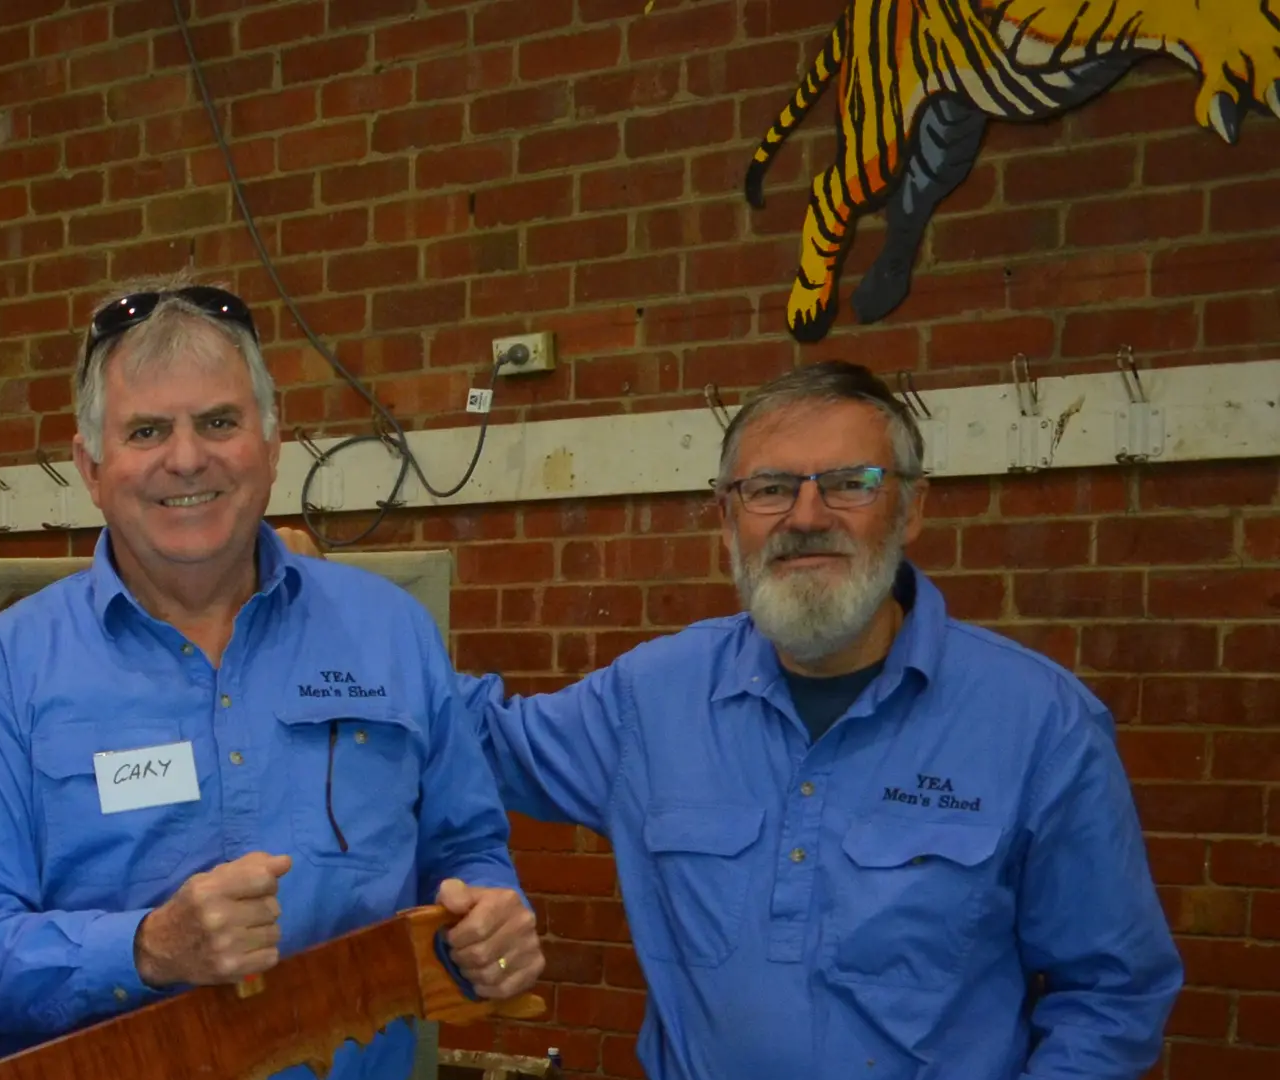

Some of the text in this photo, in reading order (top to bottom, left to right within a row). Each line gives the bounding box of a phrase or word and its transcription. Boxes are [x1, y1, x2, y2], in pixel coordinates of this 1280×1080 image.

[320, 671, 356, 683] YEA
[298, 685, 387, 698] Men's Shed
[916, 773, 954, 792] YEA
[883, 787, 981, 812] Men's Shed
